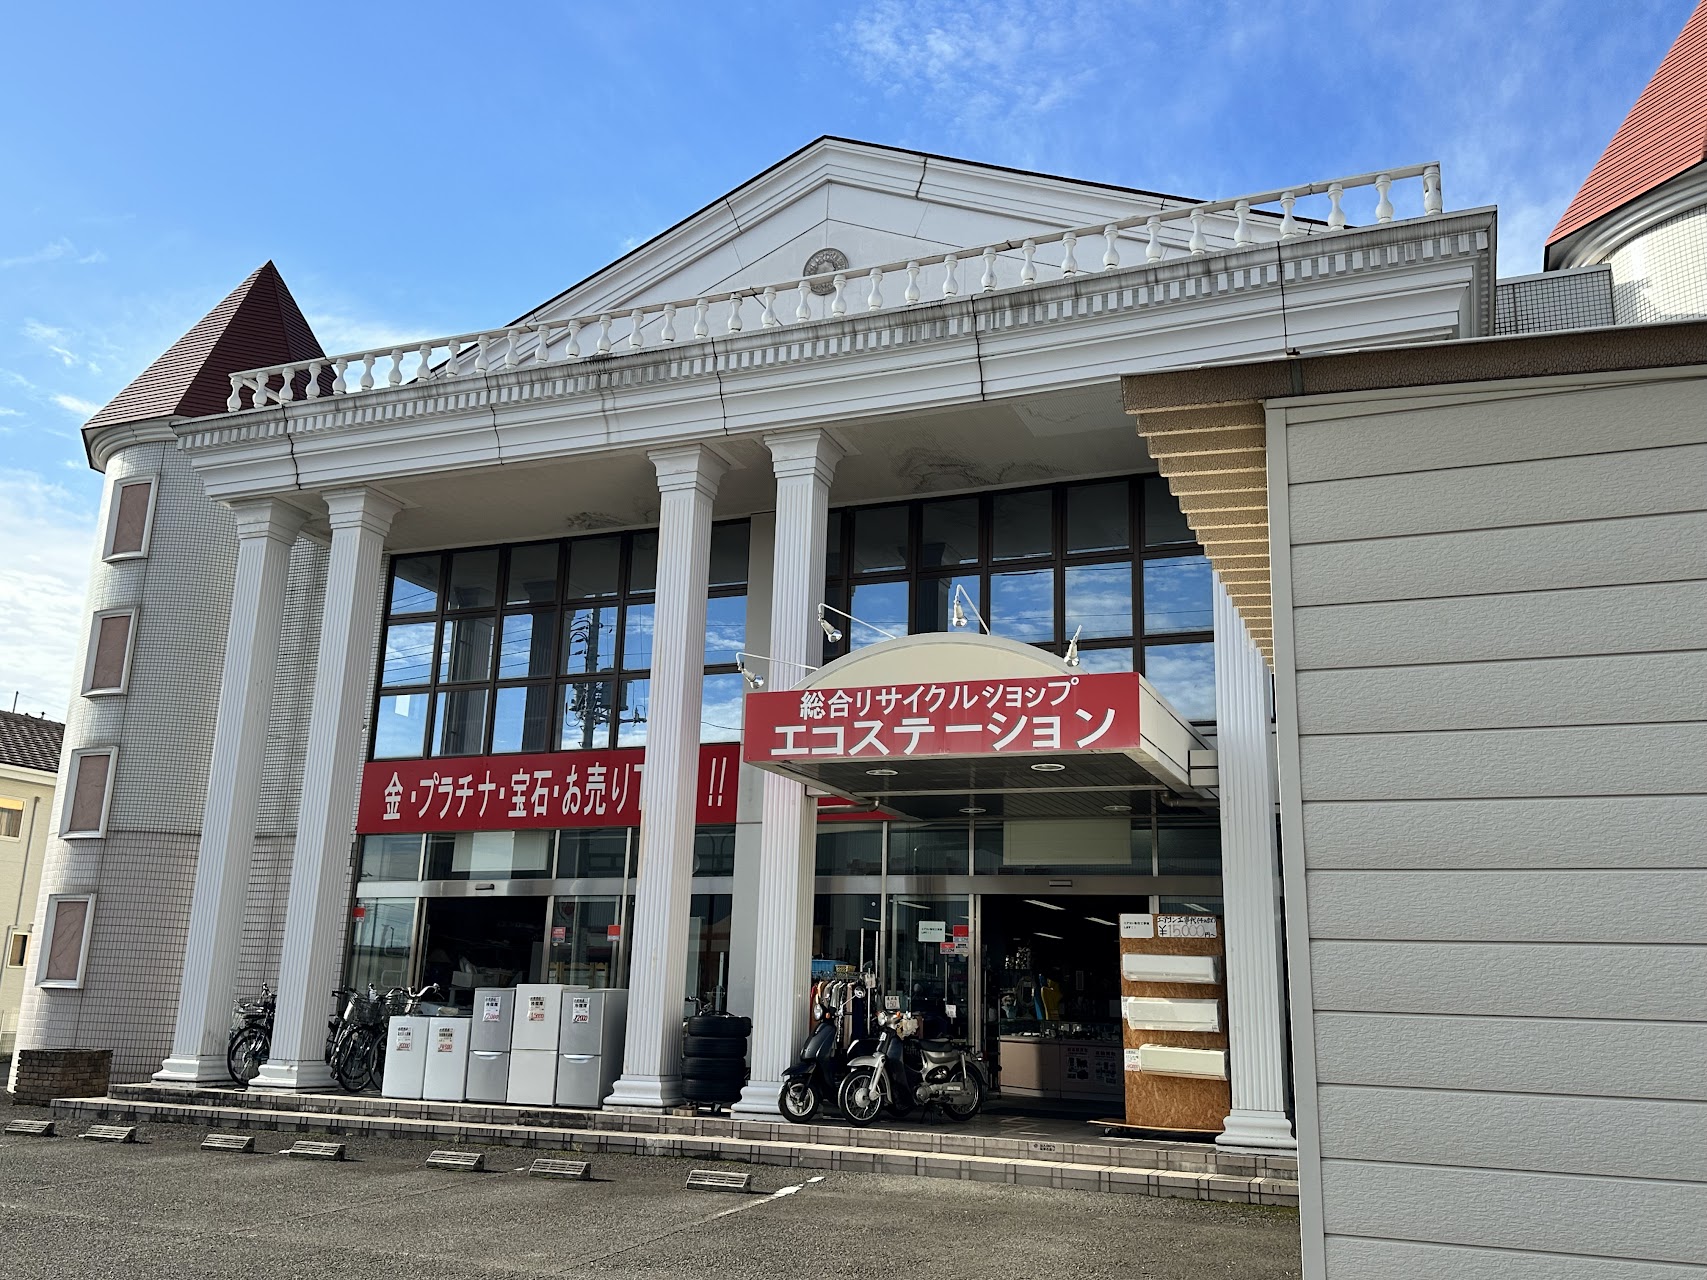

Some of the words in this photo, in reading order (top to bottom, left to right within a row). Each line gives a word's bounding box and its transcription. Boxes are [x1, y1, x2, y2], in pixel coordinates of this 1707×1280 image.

[799, 676, 1080, 720] 総合リサイクルショップ
[770, 707, 1116, 756] エコステーション
